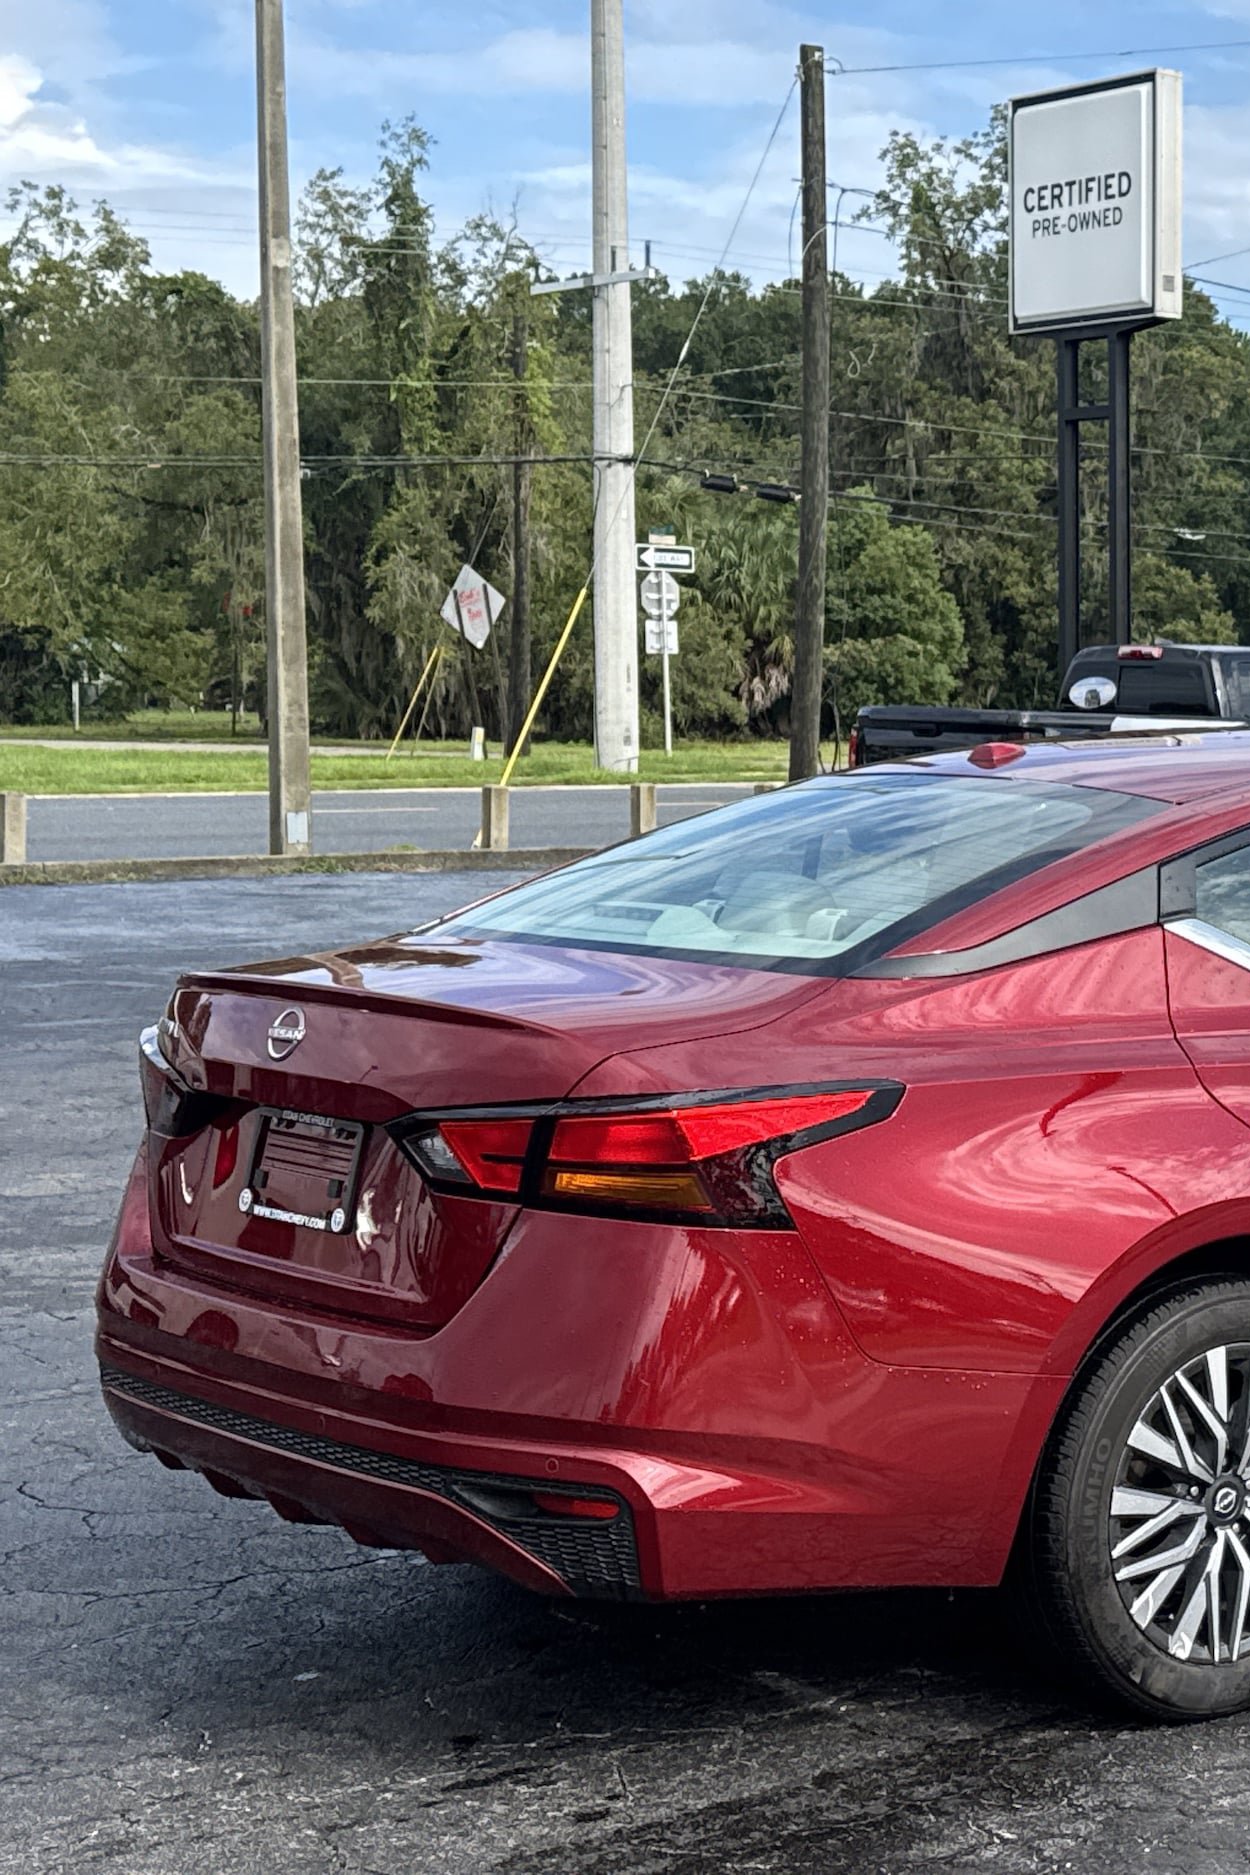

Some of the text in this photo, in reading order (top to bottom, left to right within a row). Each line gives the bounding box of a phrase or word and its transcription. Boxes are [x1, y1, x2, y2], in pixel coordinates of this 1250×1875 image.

[1023, 171, 1132, 213] CERTIFIED
[1032, 206, 1123, 239] PRE-OWNED
[1080, 1438, 1112, 1566] KUMHO
